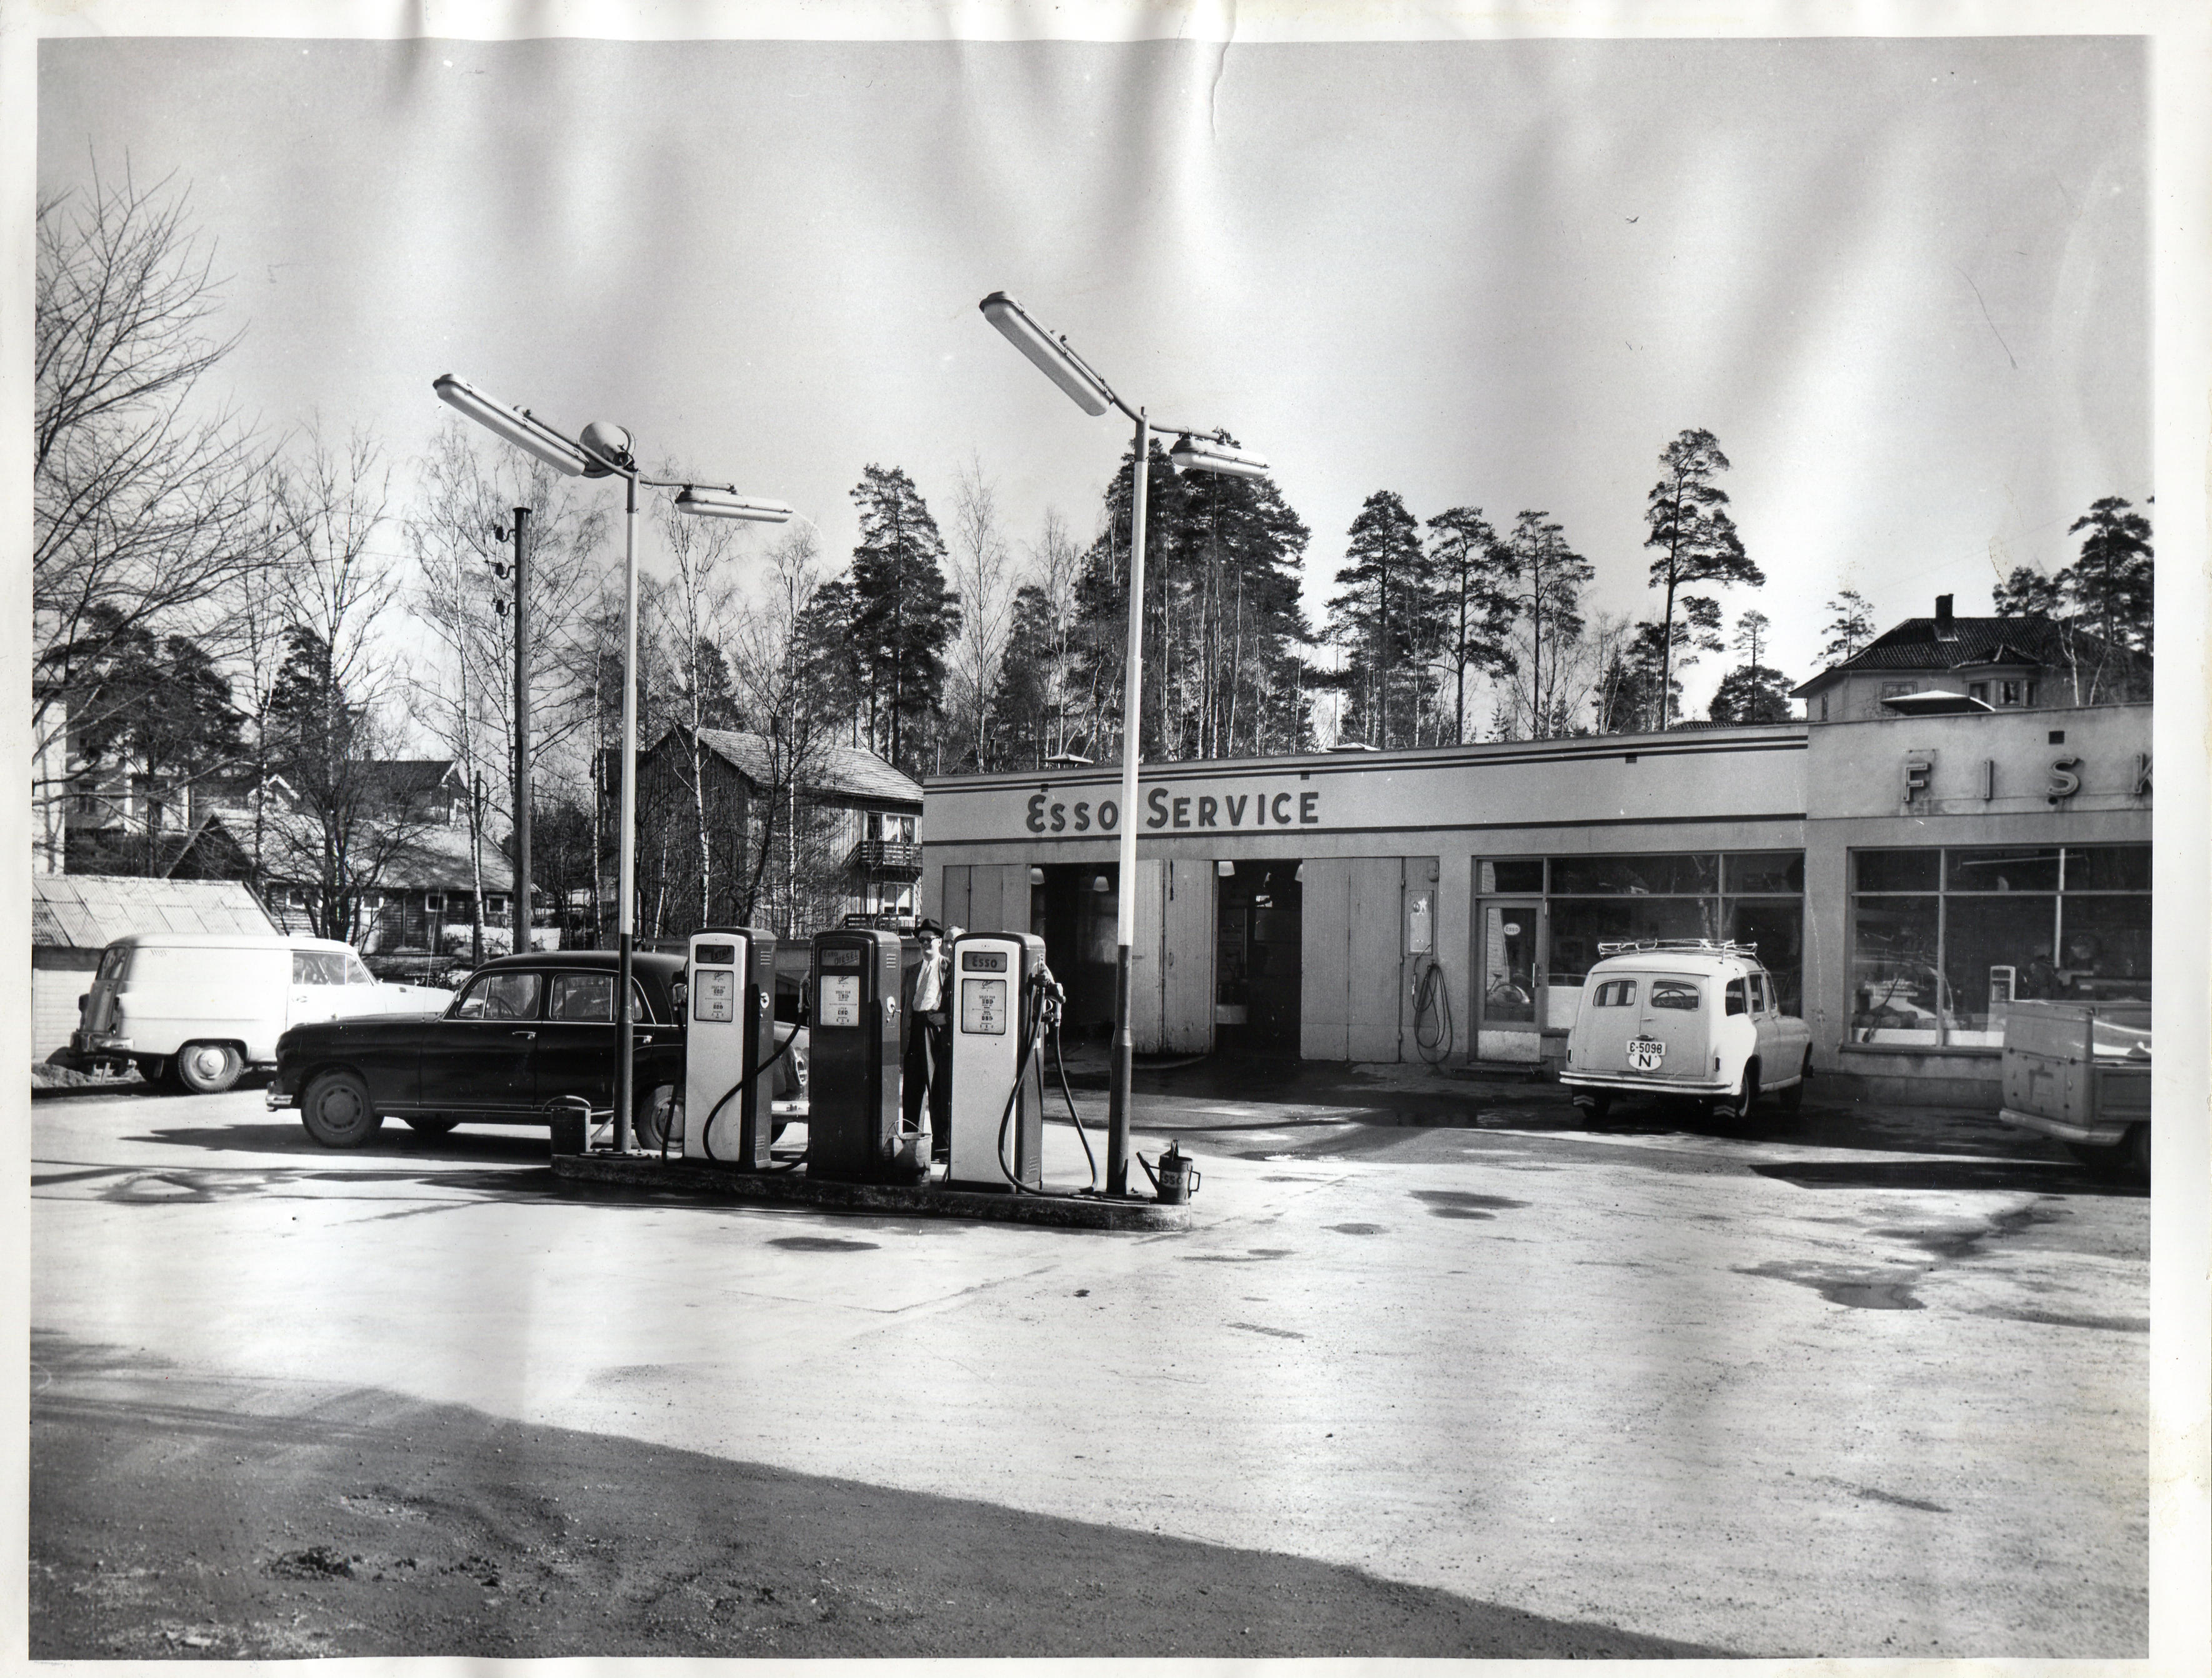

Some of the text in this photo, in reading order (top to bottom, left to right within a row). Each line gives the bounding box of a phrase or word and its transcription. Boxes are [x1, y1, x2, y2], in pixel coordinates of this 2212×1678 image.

[1026, 788, 1318, 832] ESSO SERVICE
[834, 950, 858, 966] DIESEL
[972, 955, 998, 968] ESSO
[1629, 1042, 1662, 1054] E-5098
[1639, 1054, 1651, 1067] N
